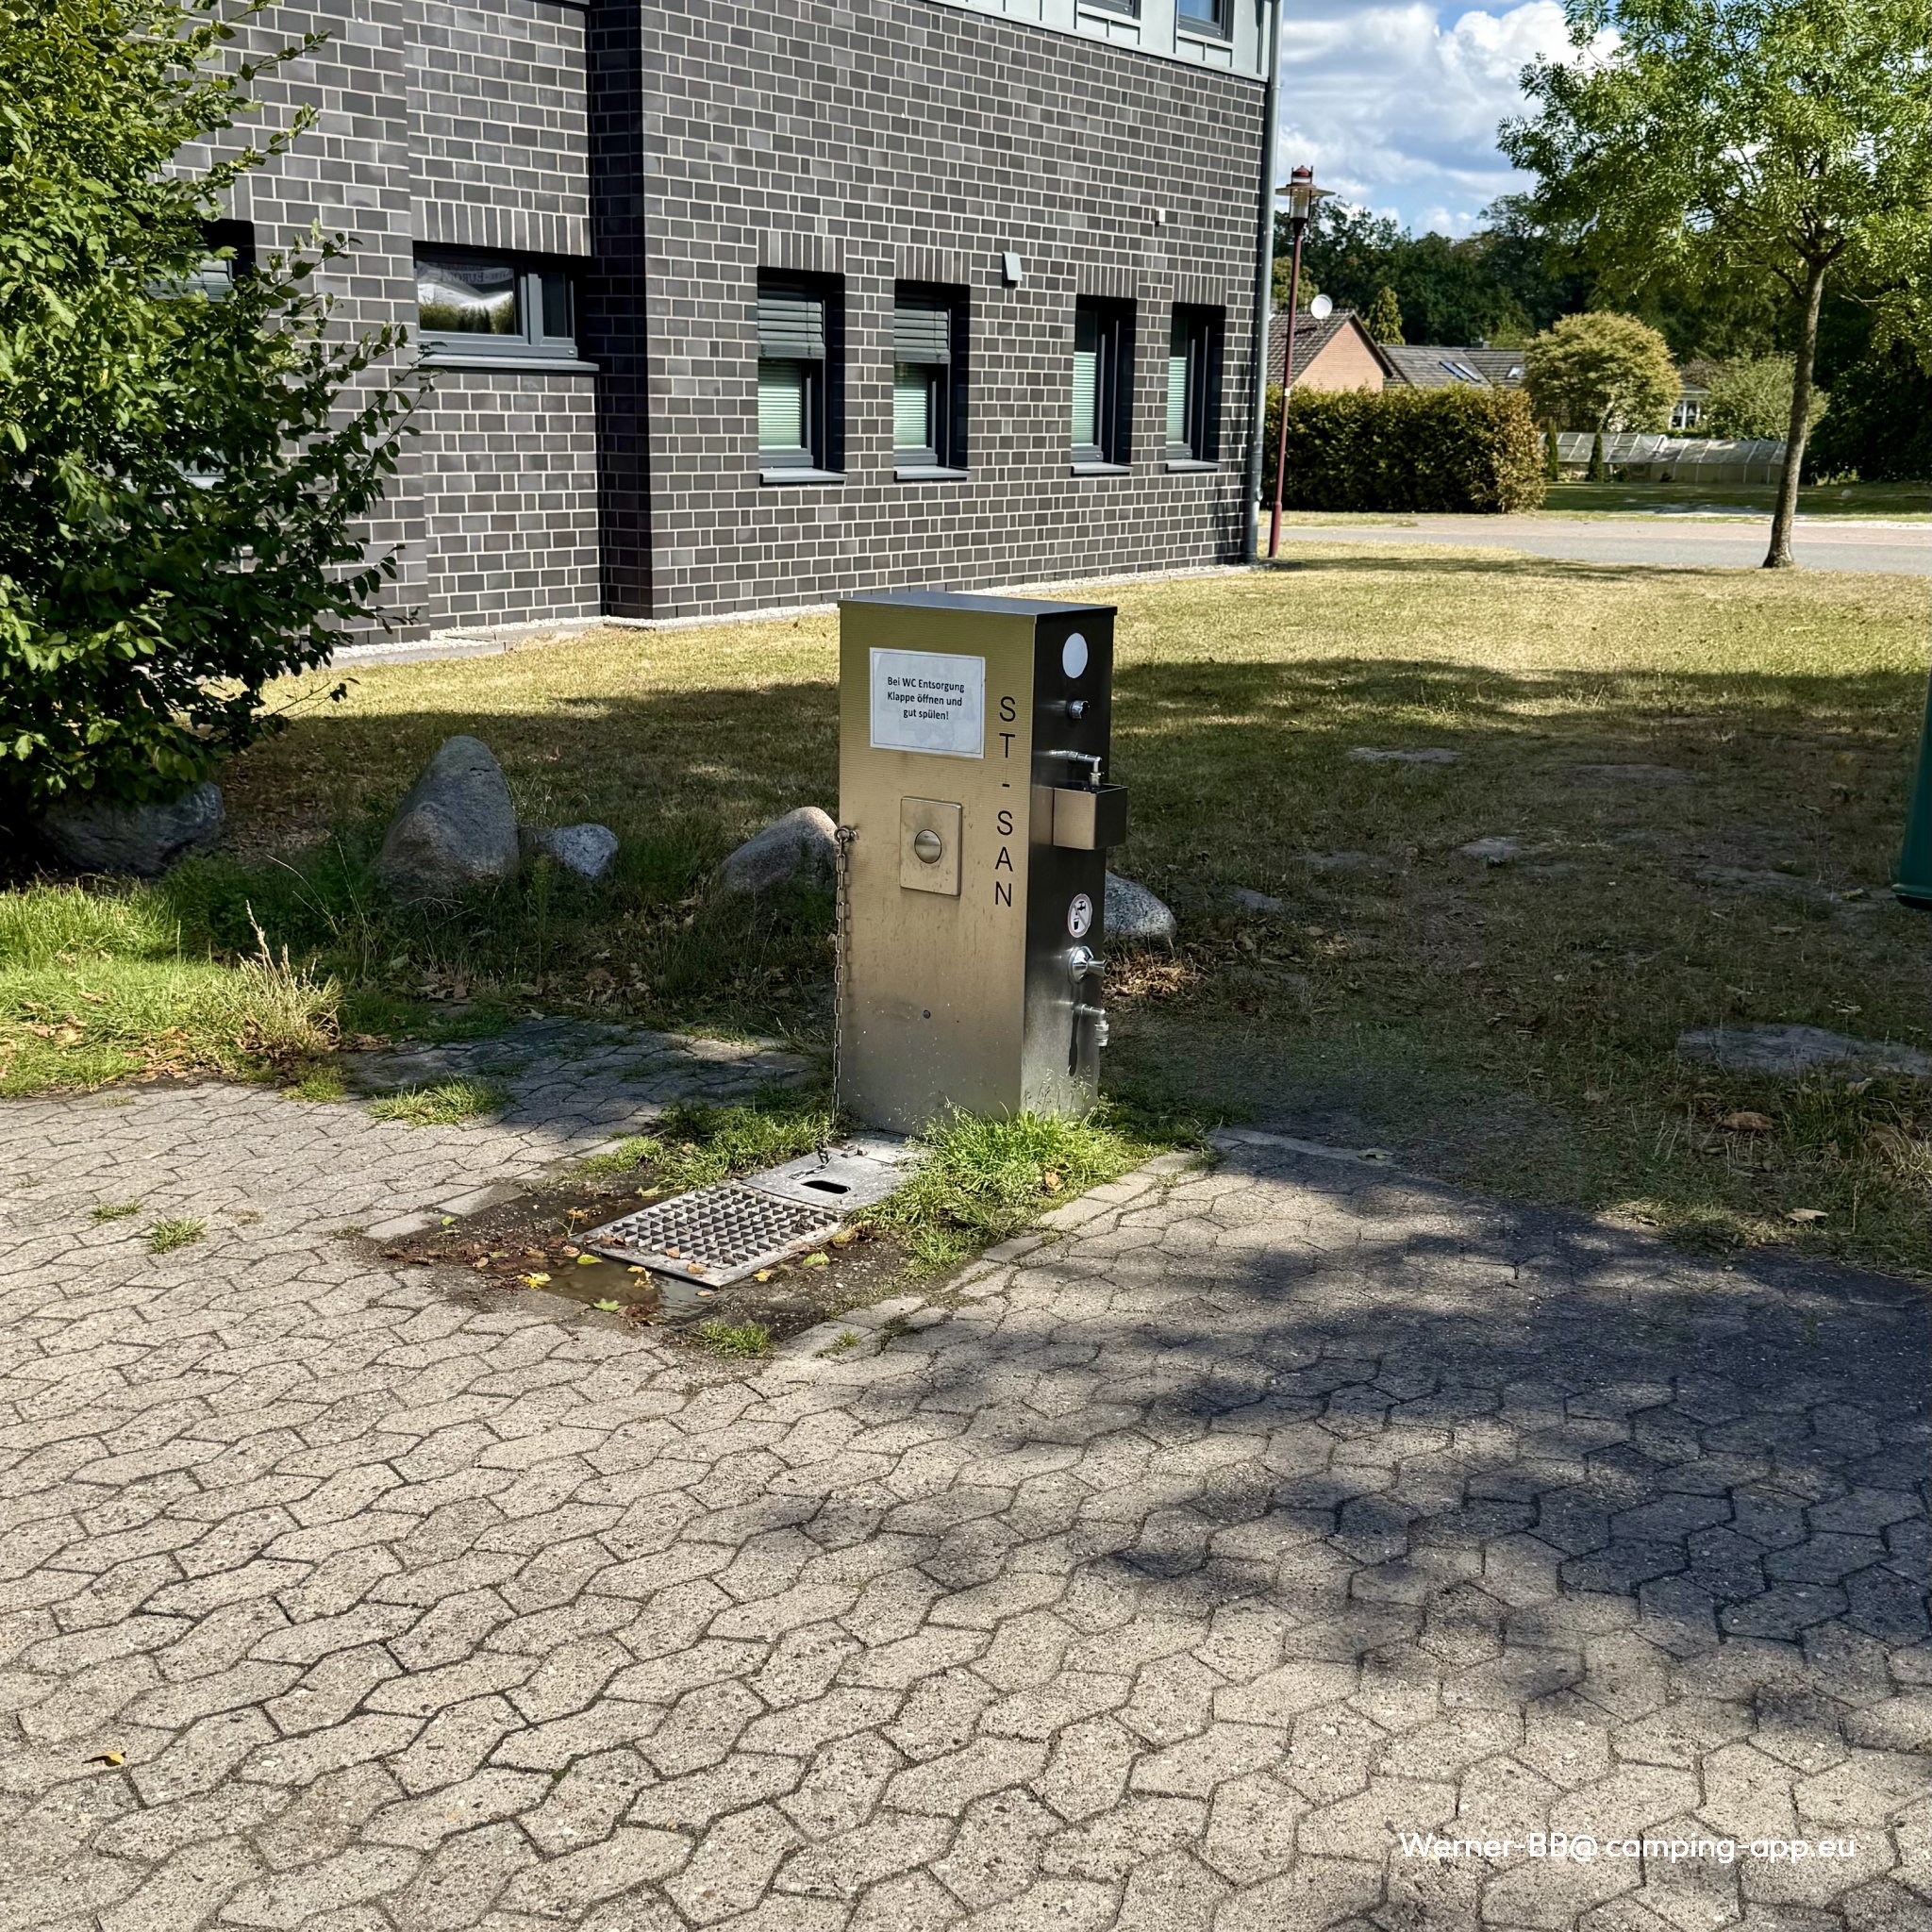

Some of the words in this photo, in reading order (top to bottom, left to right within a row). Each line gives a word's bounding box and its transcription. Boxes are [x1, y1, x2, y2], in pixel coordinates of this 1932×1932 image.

[888, 676, 900, 686] Bei
[902, 677, 917, 688] WC
[918, 678, 965, 693] Entsorgung
[887, 691, 915, 704] Klappe
[917, 693, 944, 705] öffnen
[946, 697, 962, 707] und
[903, 708, 916, 719] gut
[919, 709, 949, 720] spülen!
